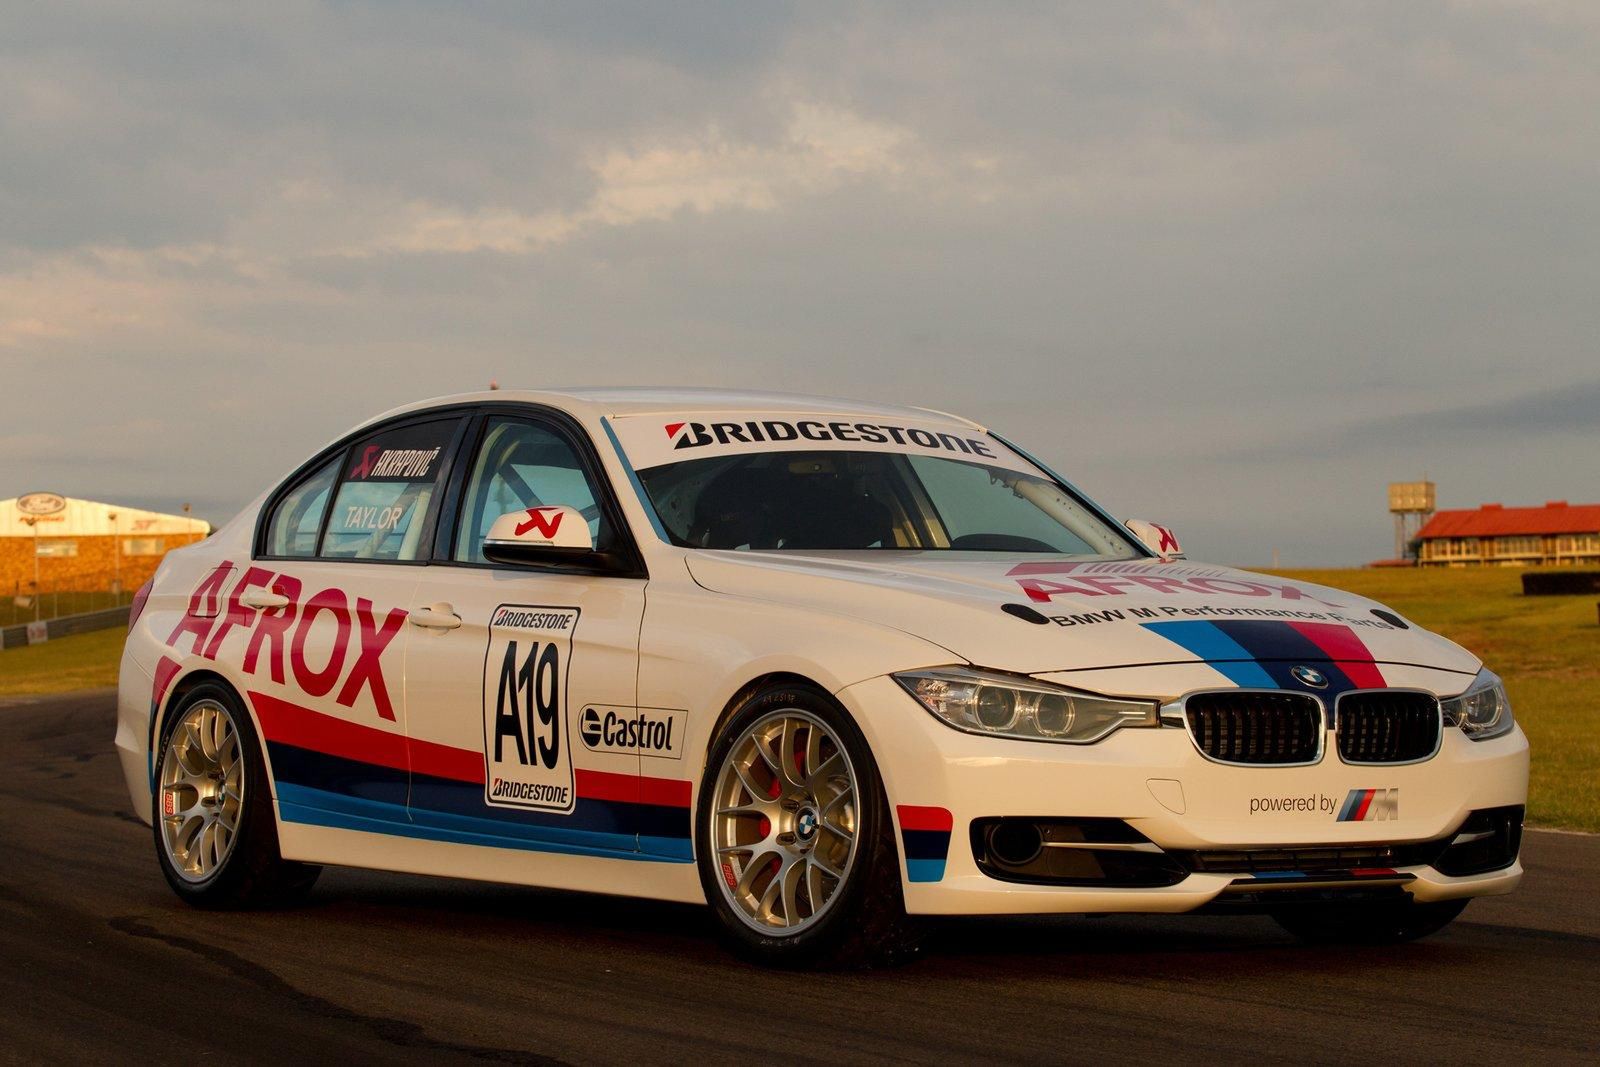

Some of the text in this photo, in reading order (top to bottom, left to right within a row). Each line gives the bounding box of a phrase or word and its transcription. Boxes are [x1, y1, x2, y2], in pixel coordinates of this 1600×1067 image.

[664, 421, 997, 459] BRIDGESTONE
[345, 506, 402, 528] TAYLOR
[1016, 575, 1348, 609] AFROX
[494, 609, 573, 630] BRIDGESTONE
[1050, 609, 1126, 627] BMW
[1127, 607, 1159, 618] M
[1158, 605, 1327, 620] Performance
[166, 560, 409, 722] AFROX
[495, 640, 560, 770] A19
[603, 711, 673, 751] Castrol
[492, 778, 568, 804] BRIDGESTONE
[1250, 794, 1316, 815] powered
[1319, 794, 1338, 815] by
